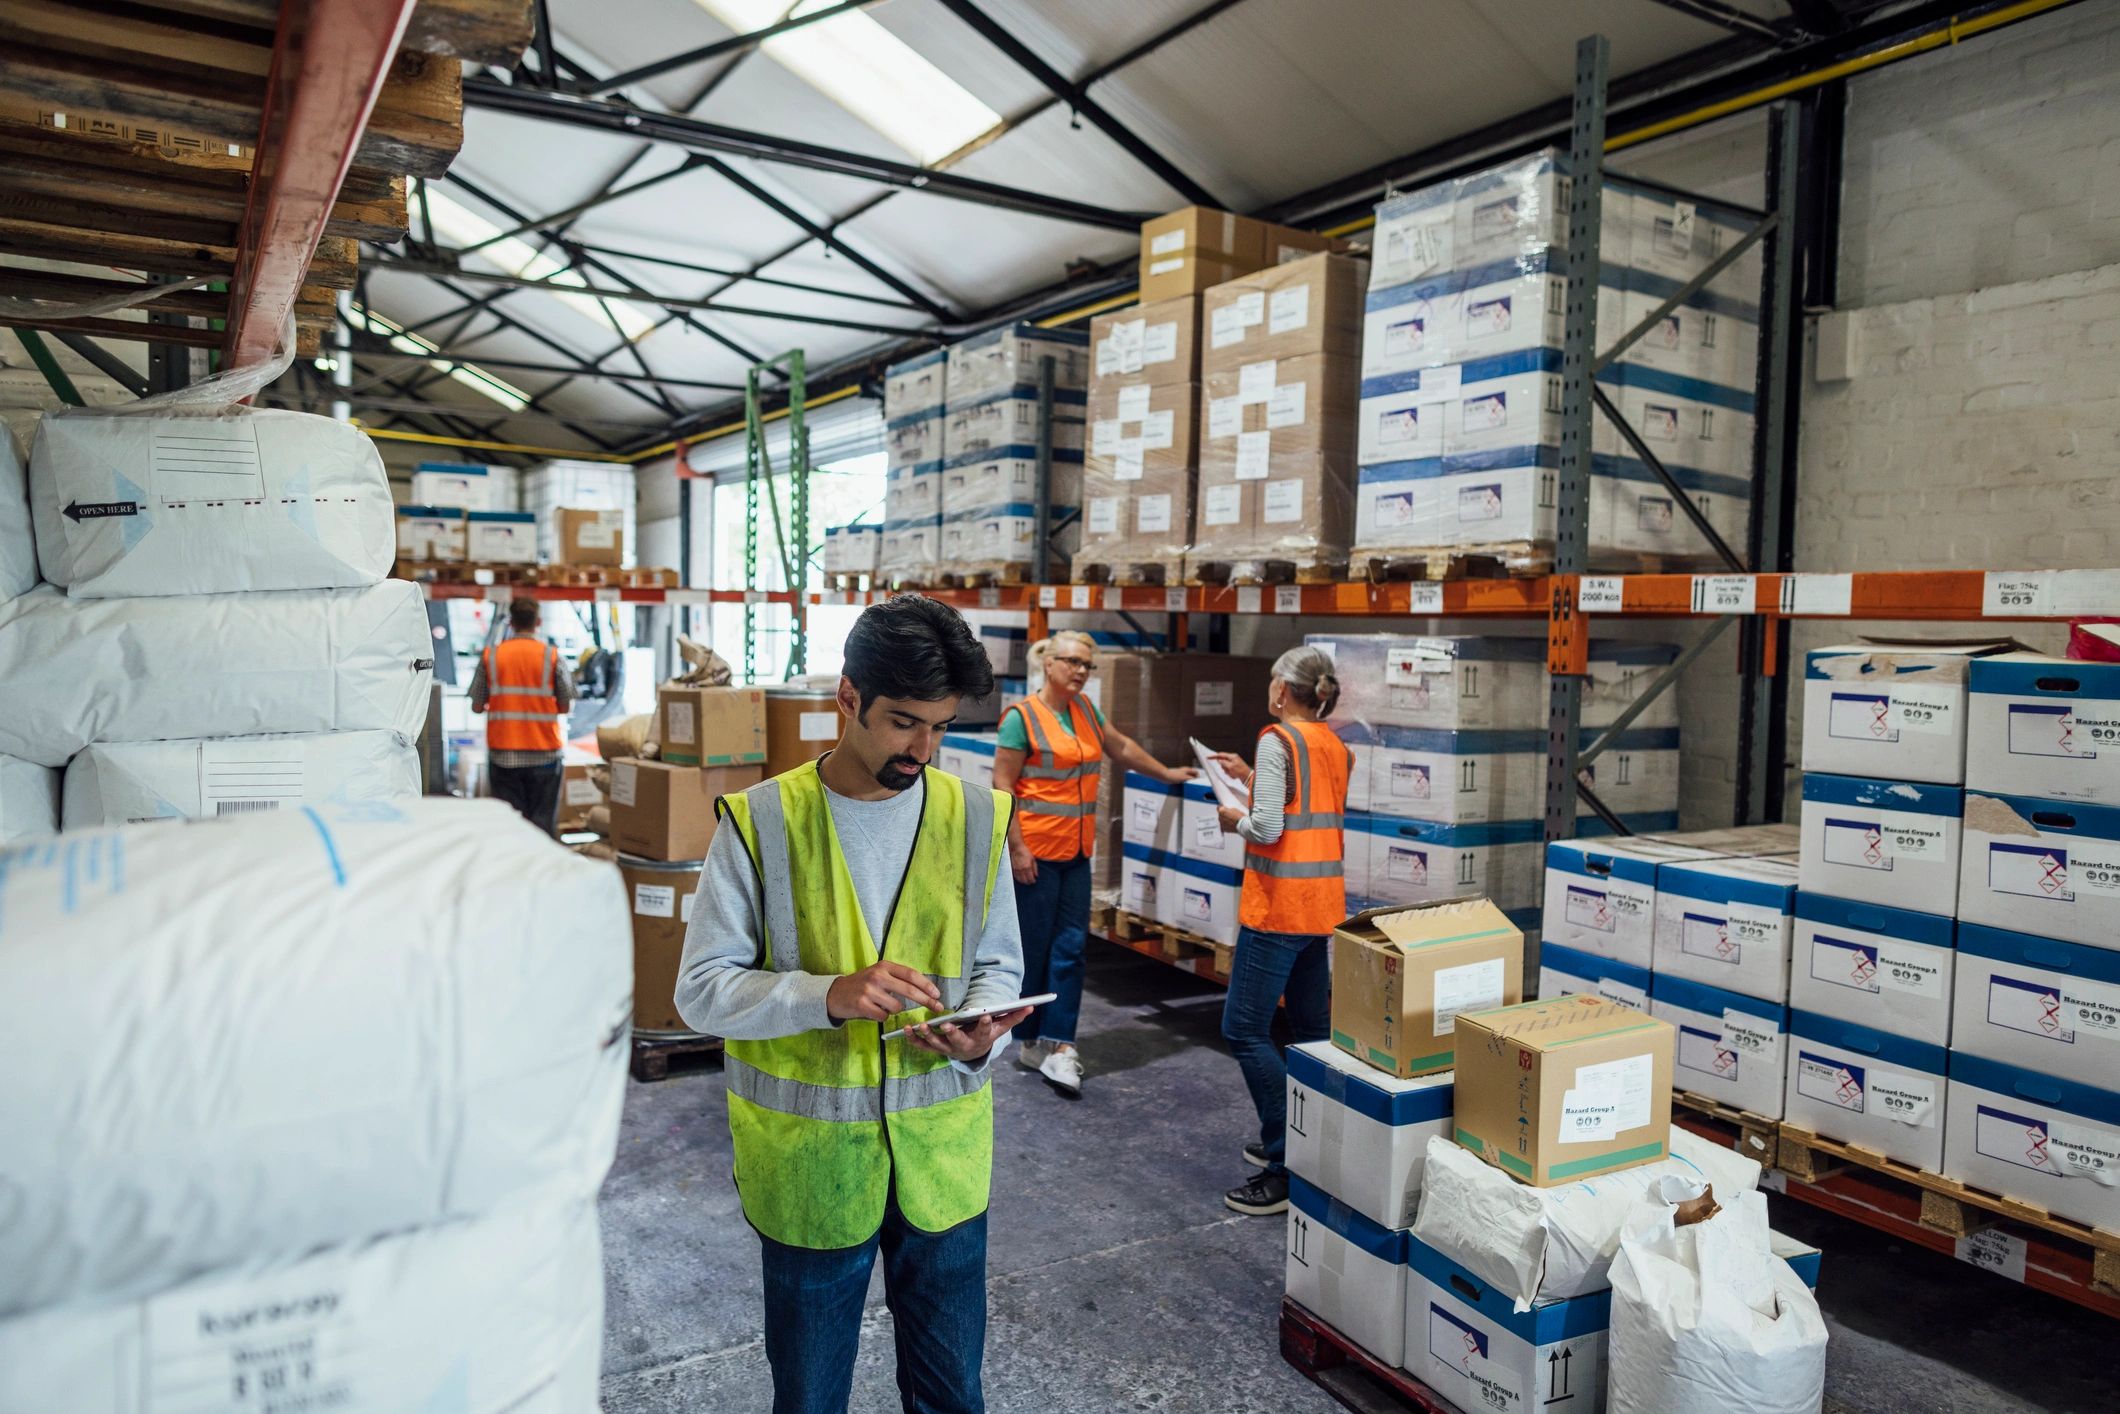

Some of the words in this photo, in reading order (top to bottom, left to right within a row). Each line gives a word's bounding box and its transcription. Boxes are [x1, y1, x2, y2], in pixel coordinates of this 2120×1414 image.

[79, 506, 105, 515] OPEN
[106, 505, 134, 514] HERE
[1919, 702, 1942, 710] Group
[2075, 718, 2109, 726] Hazard
[1911, 829, 1934, 837] Group
[2070, 859, 2102, 868] Hazard
[1880, 957, 1907, 967] Hazard
[1908, 963, 1931, 973] Group
[2063, 996, 2097, 1008] Hazard
[1872, 1085, 1898, 1095] Hazard
[1899, 1091, 1923, 1101] Group
[2051, 1138, 2084, 1150] Hazard
[2086, 1146, 2115, 1159] Group
[1470, 1371, 1492, 1388] Hazard
[1493, 1383, 1514, 1399] Group
